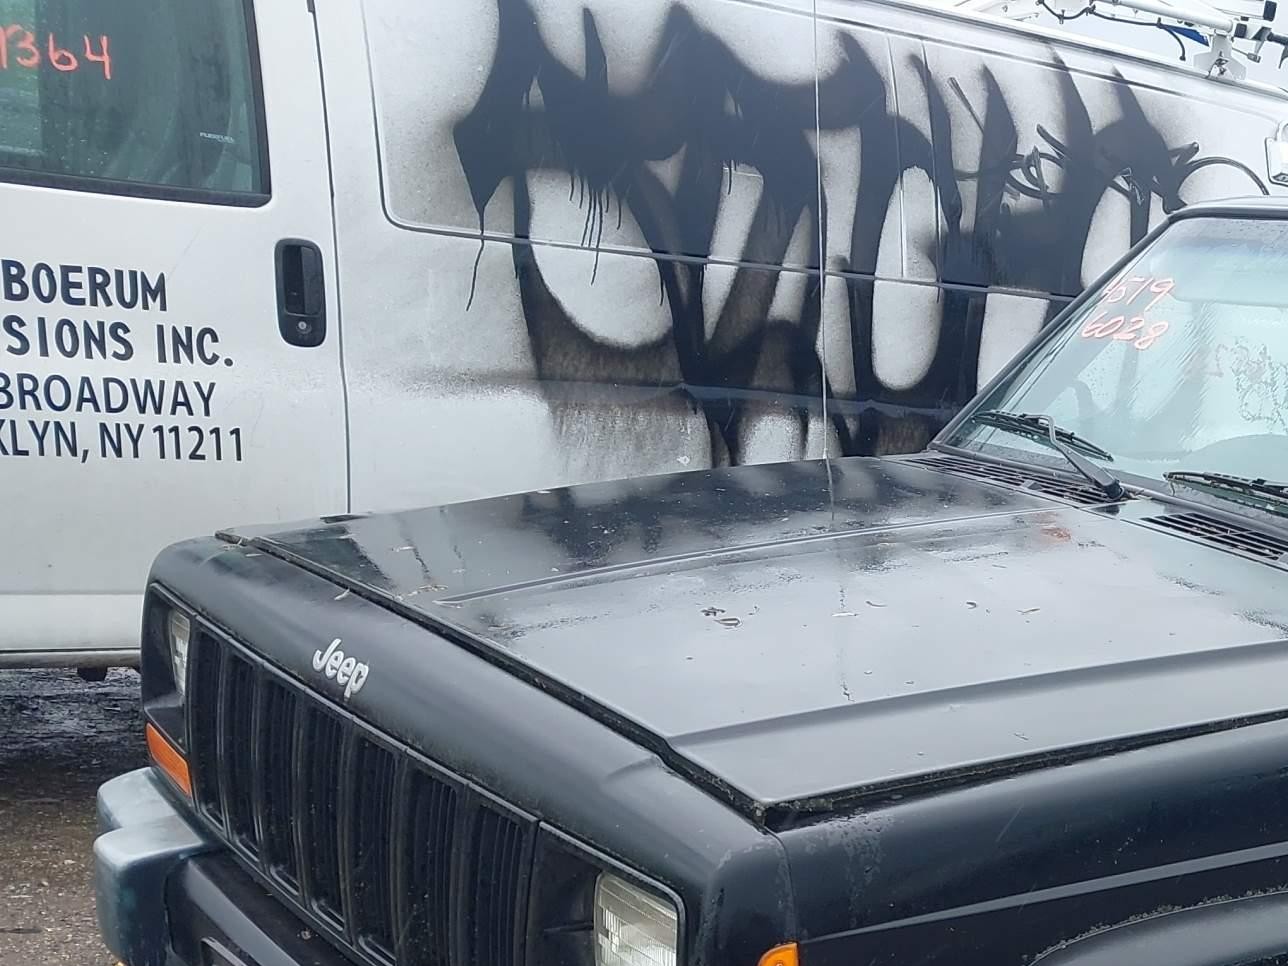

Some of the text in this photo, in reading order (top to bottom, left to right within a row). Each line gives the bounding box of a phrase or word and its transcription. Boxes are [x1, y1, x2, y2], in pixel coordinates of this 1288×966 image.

[1, 259, 168, 312] BOERUM
[2, 314, 234, 367] SIONS INC.
[1081, 311, 1169, 351] 6028
[0, 372, 216, 418] BROADWAY
[99, 422, 145, 459] NY
[152, 424, 242, 462] 11211
[312, 638, 369, 699] Jeep
